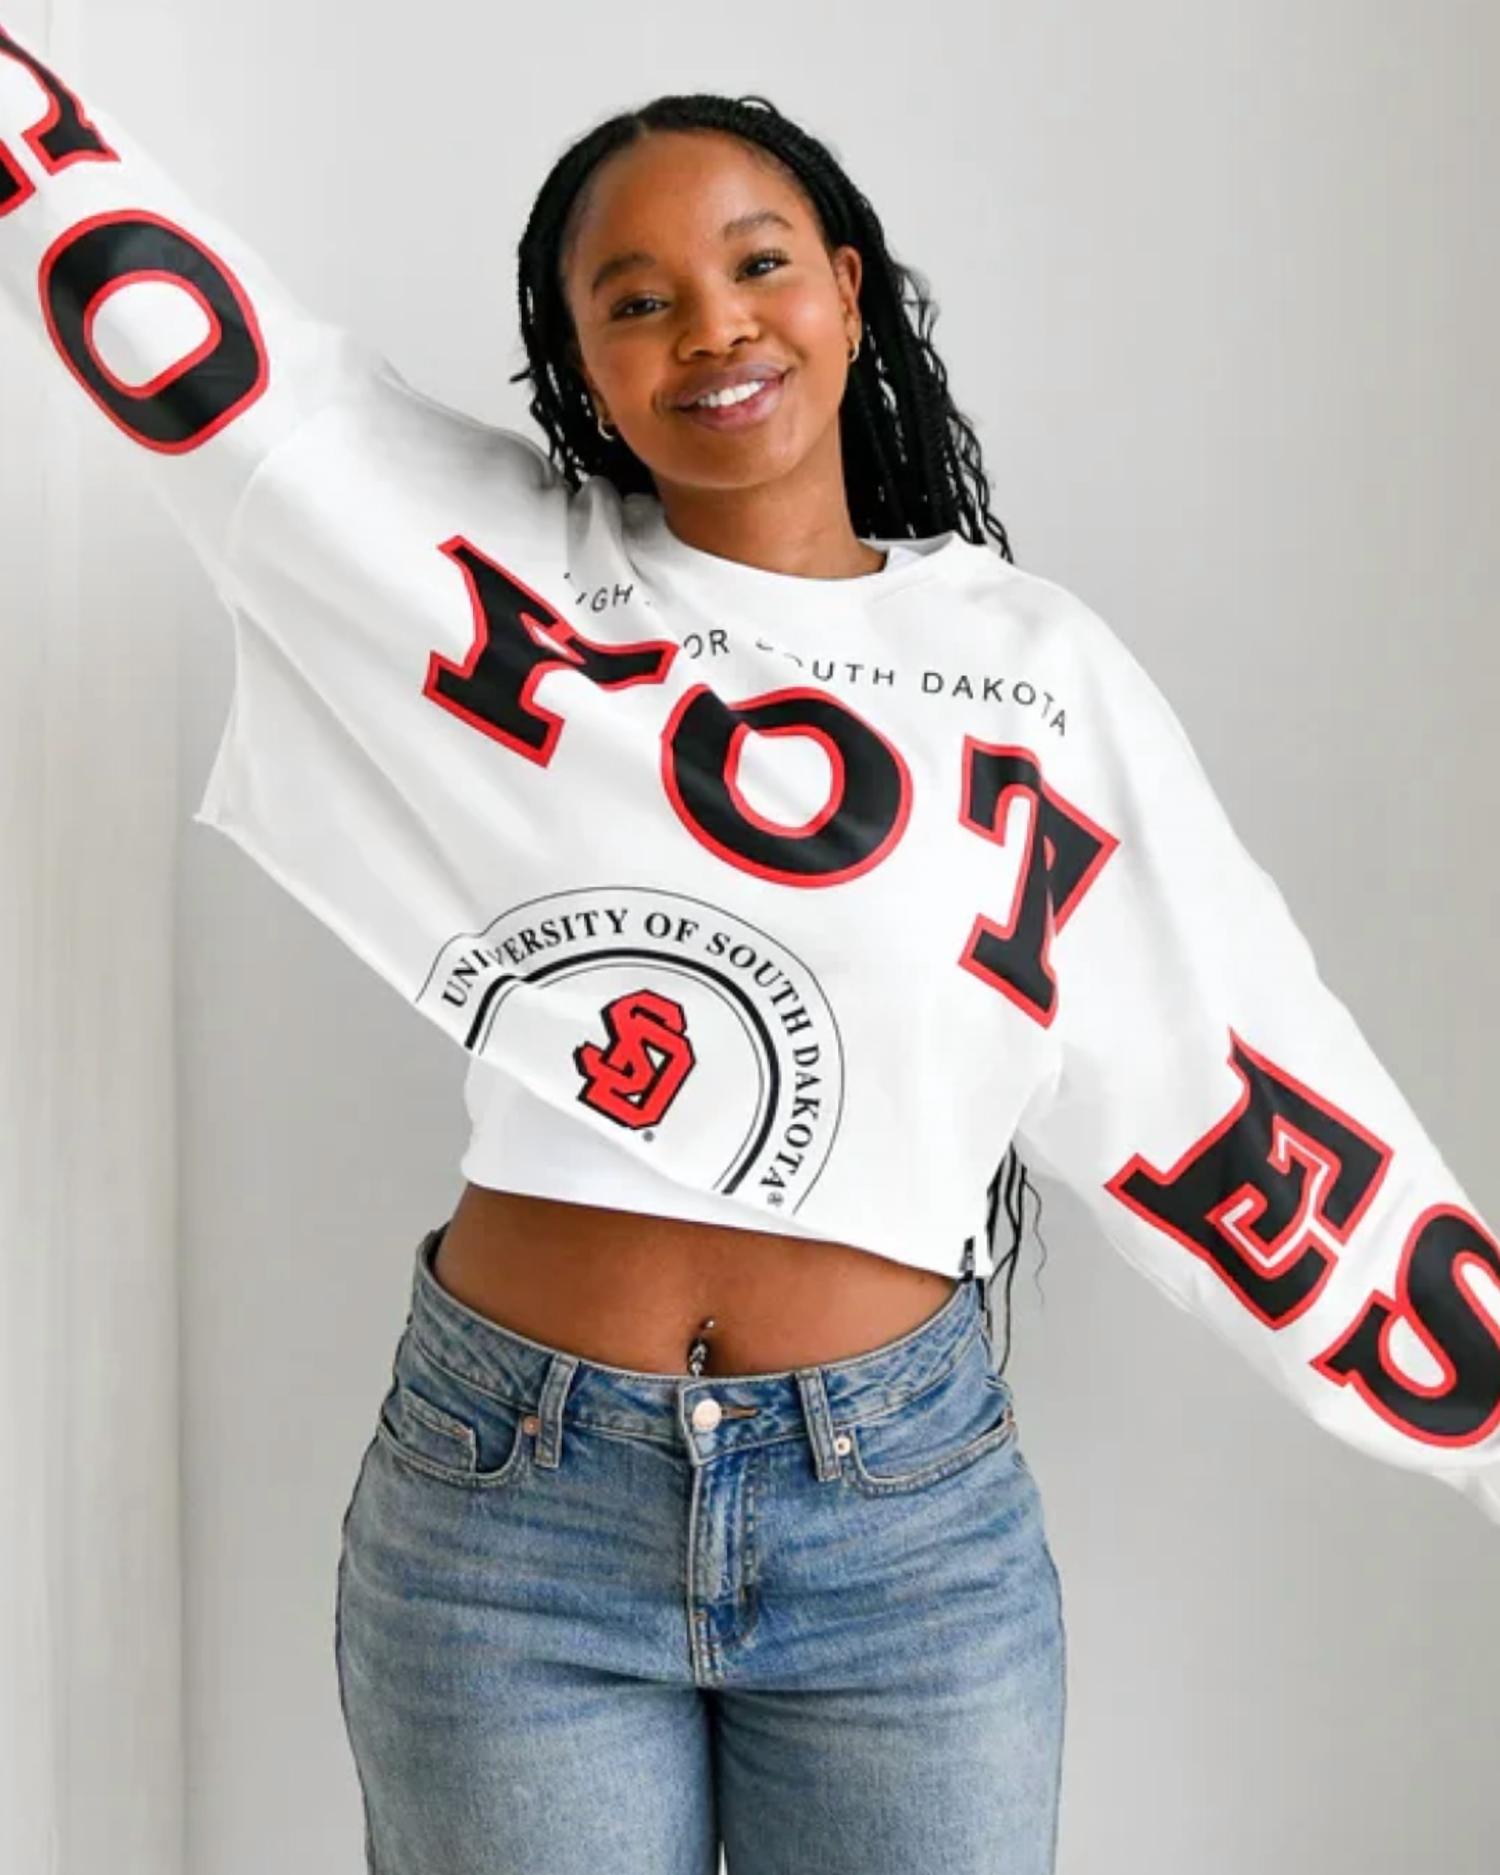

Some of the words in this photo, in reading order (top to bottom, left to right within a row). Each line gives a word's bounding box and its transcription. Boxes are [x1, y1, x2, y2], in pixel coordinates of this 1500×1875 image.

[683, 629, 730, 660] OR
[922, 671, 1068, 736] DAKOTA
[440, 908, 630, 1010] UNIVERSITY
[644, 911, 700, 943] OF
[705, 934, 815, 1037] SOUTH
